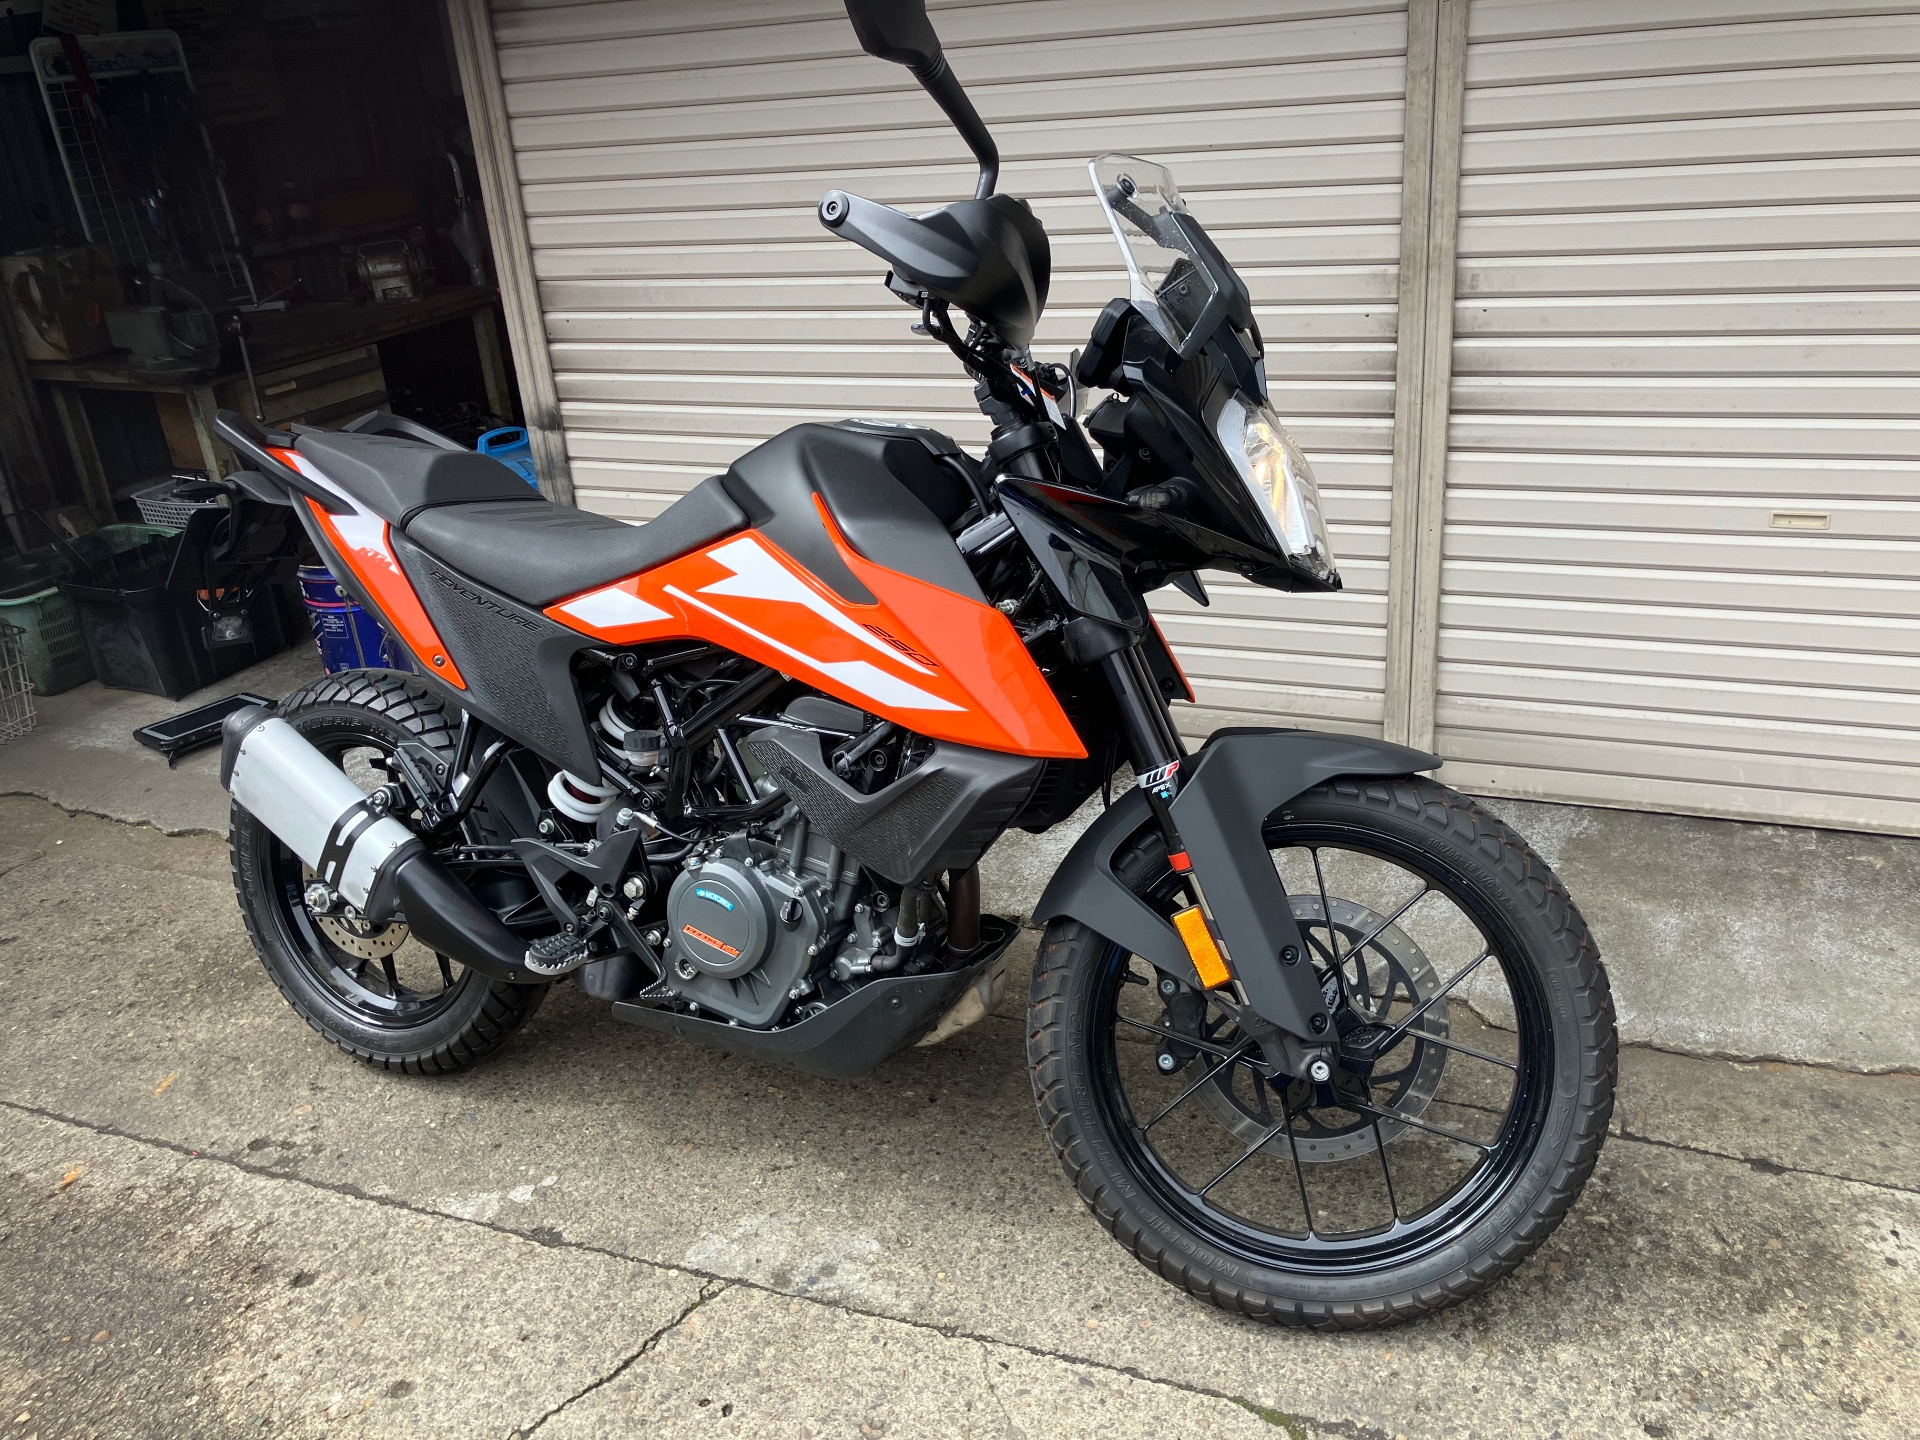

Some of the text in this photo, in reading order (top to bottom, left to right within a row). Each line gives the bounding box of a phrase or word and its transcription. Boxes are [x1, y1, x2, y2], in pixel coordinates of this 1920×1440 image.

[430, 571, 542, 632] ADVENTURE
[1145, 760, 1179, 785] WP
[1151, 781, 1172, 795] APEX
[1134, 1202, 1240, 1279] MOGRIP
[1476, 1178, 1538, 1252] MRF
